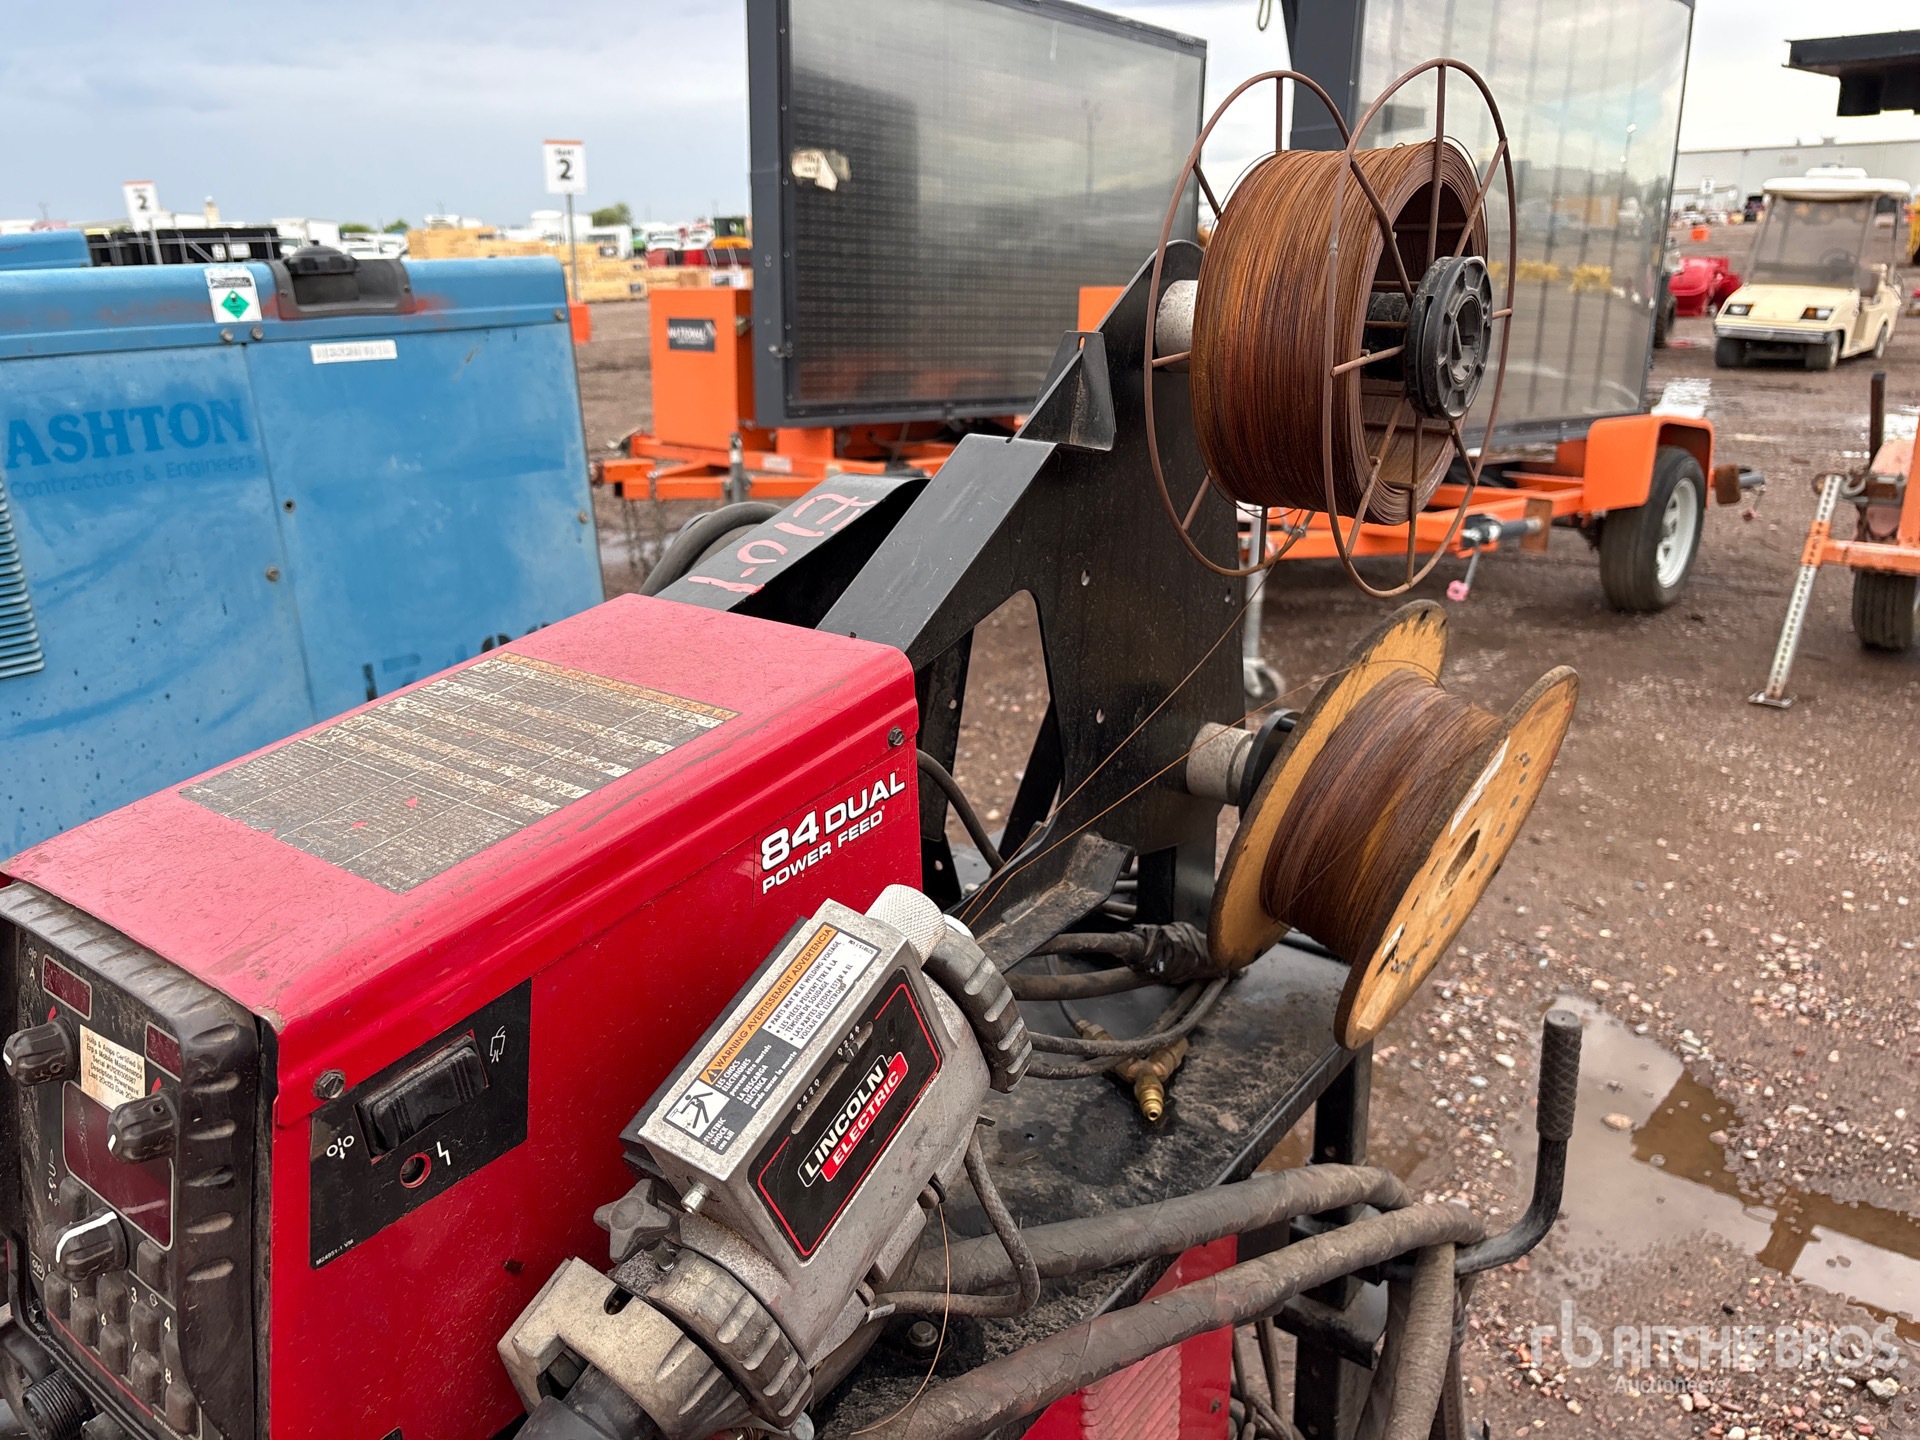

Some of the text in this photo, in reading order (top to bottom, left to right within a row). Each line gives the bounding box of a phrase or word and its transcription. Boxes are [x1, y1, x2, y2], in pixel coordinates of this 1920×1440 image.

[556, 158, 573, 181] 2
[136, 195, 149, 211] 2
[5, 400, 249, 469] ASHTON
[144, 466, 157, 482] &
[166, 455, 256, 480] Engineers
[761, 772, 905, 871] 84 DUAL
[762, 810, 883, 895] POWER FEED
[714, 927, 832, 1068] WARNING AVERTISSEMENT ADVERTENCIA
[770, 940, 841, 1025] PARTS MAY BE AT WELDING VOLTAGE
[778, 1020, 788, 1030] LES
[829, 958, 838, 966] LA
[784, 980, 829, 1033] TENSION DE SOUDAGE
[792, 1025, 803, 1037] LAS
[800, 1007, 818, 1027] PARTES
[814, 988, 833, 1008] PUEDEN
[829, 974, 844, 989] ESTAR
[798, 1018, 818, 1040] VOLTAJE
[815, 1009, 825, 1019] DEL
[714, 1059, 741, 1088] LES CHOCS
[728, 1074, 749, 1096] peuvent
[752, 1043, 772, 1063] mortels
[736, 1063, 768, 1100] LA DESCARGA
[748, 1049, 798, 1109] puede causar la muerte
[703, 1116, 726, 1142] ELECTRIC
[709, 1125, 729, 1146] SHOCK
[804, 1064, 885, 1178] LINCOLN
[832, 1071, 899, 1166] ELECTRIC
[716, 1129, 735, 1150] can kill
[131, 1287, 138, 1303] 3
[101, 1313, 107, 1326] 6
[163, 1316, 171, 1332] 4
[164, 1367, 172, 1385] 8
